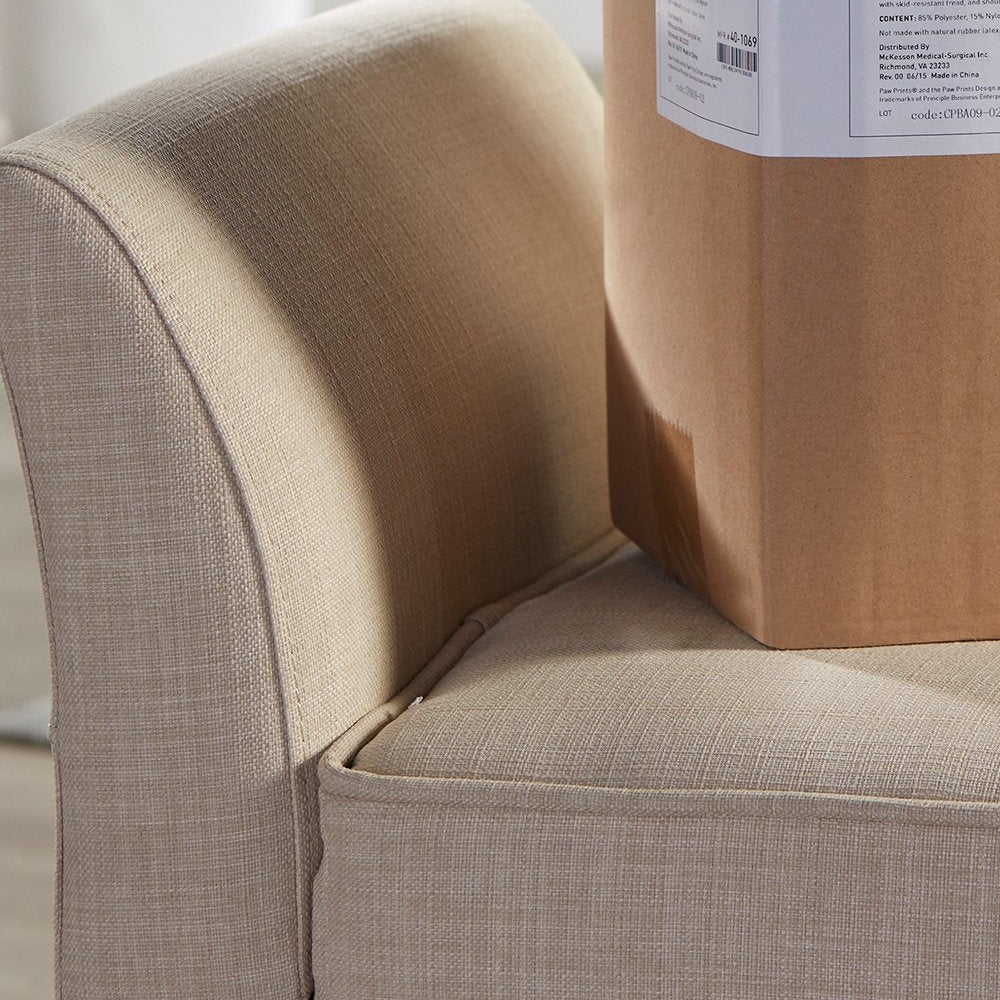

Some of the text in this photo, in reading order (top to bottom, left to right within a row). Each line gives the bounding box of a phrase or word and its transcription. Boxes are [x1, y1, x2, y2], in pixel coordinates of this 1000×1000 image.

[896, 0, 945, 8] skid-resistant
[918, 14, 933, 22] 85%
[914, 28, 929, 36] with
[930, 28, 956, 36] natural
[730, 30, 758, 48] 40-1069
[920, 43, 930, 51] By
[916, 52, 976, 60] Medical-Surgical
[879, 62, 950, 71] Richmond, VA 23233
[959, 70, 980, 78] China
[923, 94, 950, 102] Principle
